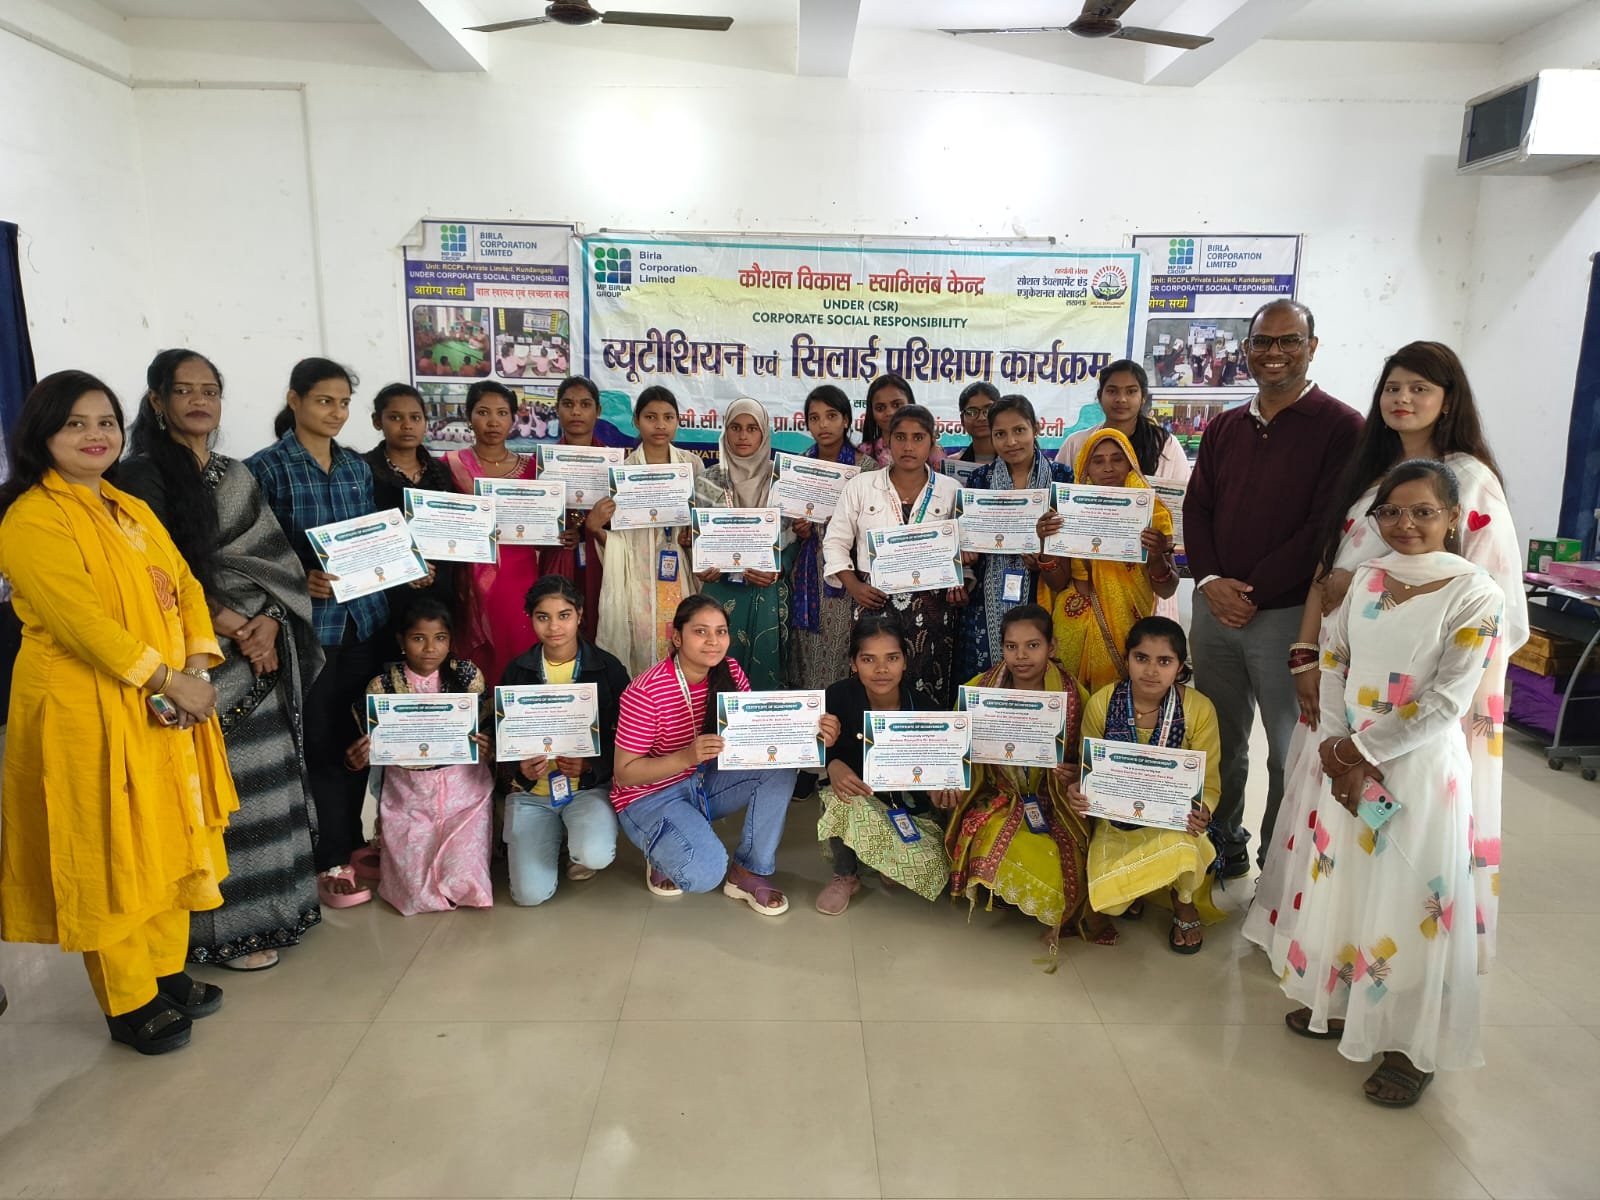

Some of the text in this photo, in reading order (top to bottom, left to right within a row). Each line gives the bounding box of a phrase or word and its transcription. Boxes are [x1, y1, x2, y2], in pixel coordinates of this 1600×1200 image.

[480, 232, 503, 240] BIRLA
[480, 240, 537, 249] CORPORATION
[1207, 244, 1230, 252] BIRLA
[480, 249, 513, 257] LIMITED
[639, 251, 662, 260] Birla
[1207, 252, 1262, 260] CORPORATION
[639, 263, 697, 273] Corporation
[409, 271, 568, 283] UNDER CORPORATE SOCIAL RESPONSIBILITY
[639, 275, 676, 284] Limited
[738, 262, 793, 289] कौशल
[797, 265, 852, 291] विकास
[946, 269, 986, 296] केन्द्र
[1017, 275, 1040, 286] सोशल
[414, 283, 442, 296] आरोग्य
[446, 283, 467, 296] सखी
[1233, 284, 1290, 292] RESPONSIBILITY
[823, 299, 899, 313] UNDER (CSR)
[1169, 296, 1188, 309] सखी
[752, 312, 968, 329] CORPORATE SOCIAL RESPONSIBILITY
[601, 328, 748, 383] ब्यूटीशियन
[752, 350, 781, 377] एवं
[790, 333, 879, 384] सिलाई
[1000, 339, 1112, 385] कार्यक्रम
[774, 411, 808, 432] प्रा.लि
